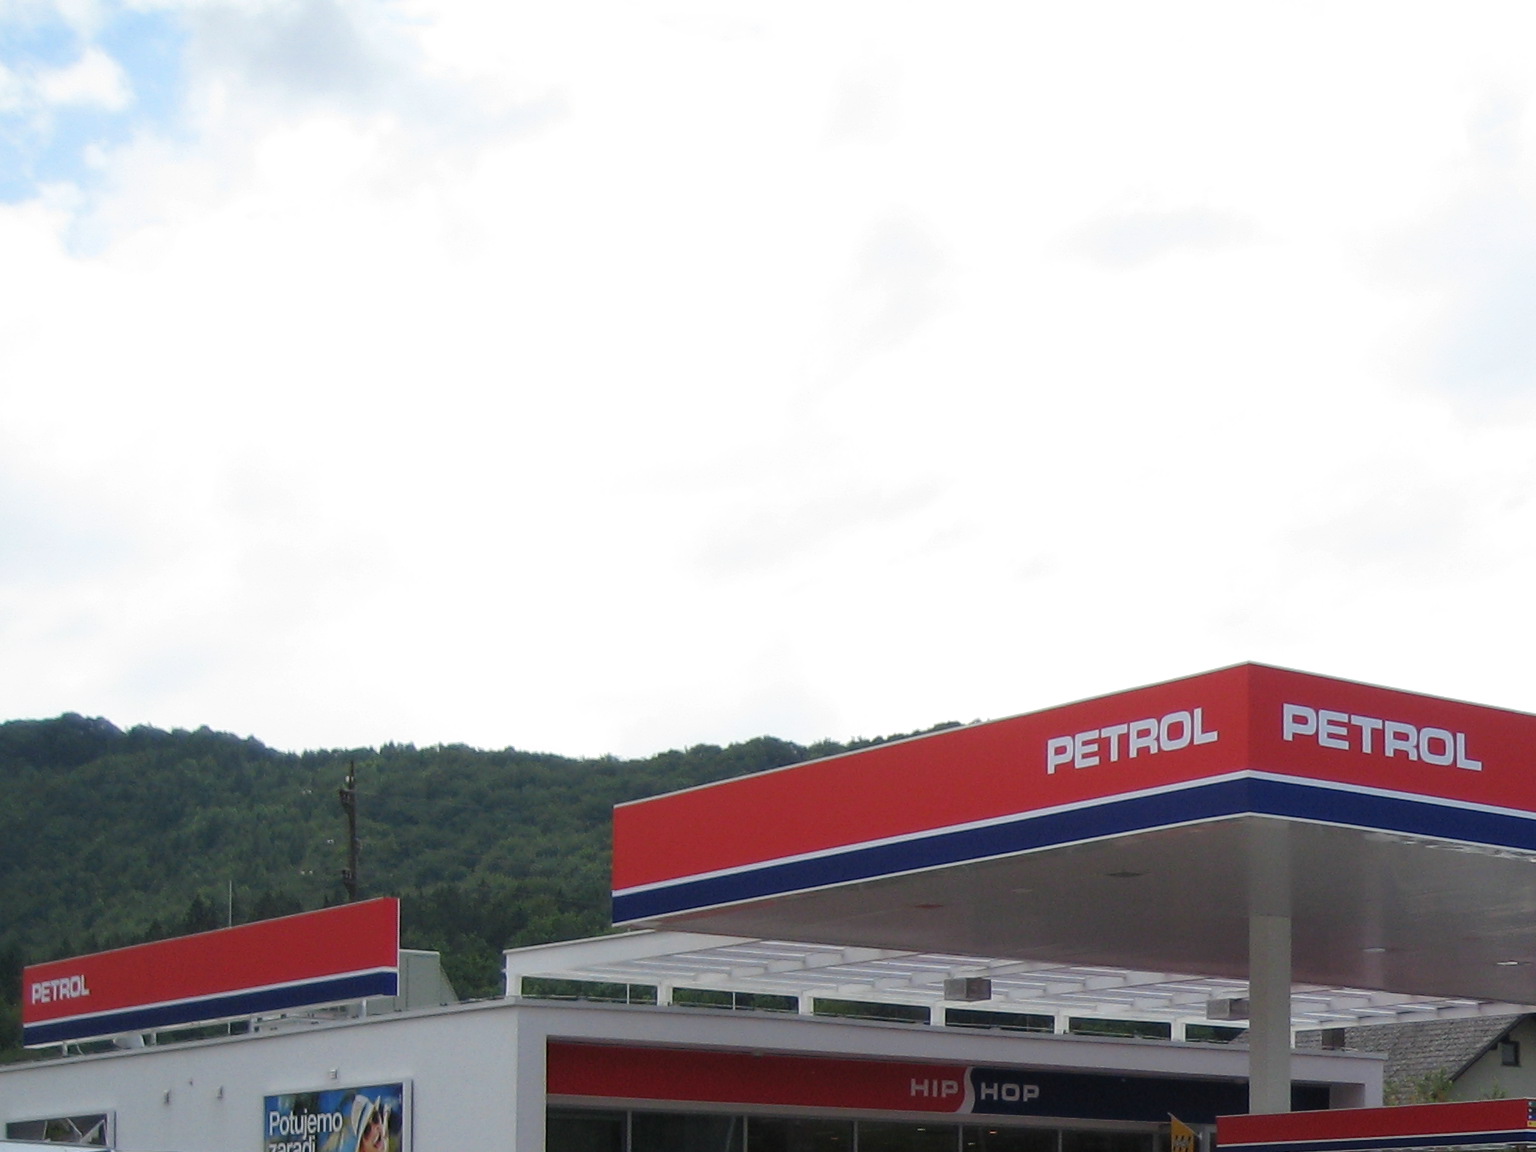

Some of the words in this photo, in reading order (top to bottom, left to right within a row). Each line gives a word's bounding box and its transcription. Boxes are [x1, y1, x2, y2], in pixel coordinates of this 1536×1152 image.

[1047, 707, 1218, 775] PETROL
[1283, 703, 1482, 771] PETROL
[32, 974, 91, 1005] PETROL
[910, 1078, 959, 1097] HIP
[980, 1082, 1040, 1102] HOP
[269, 1108, 343, 1137] Potujemo
